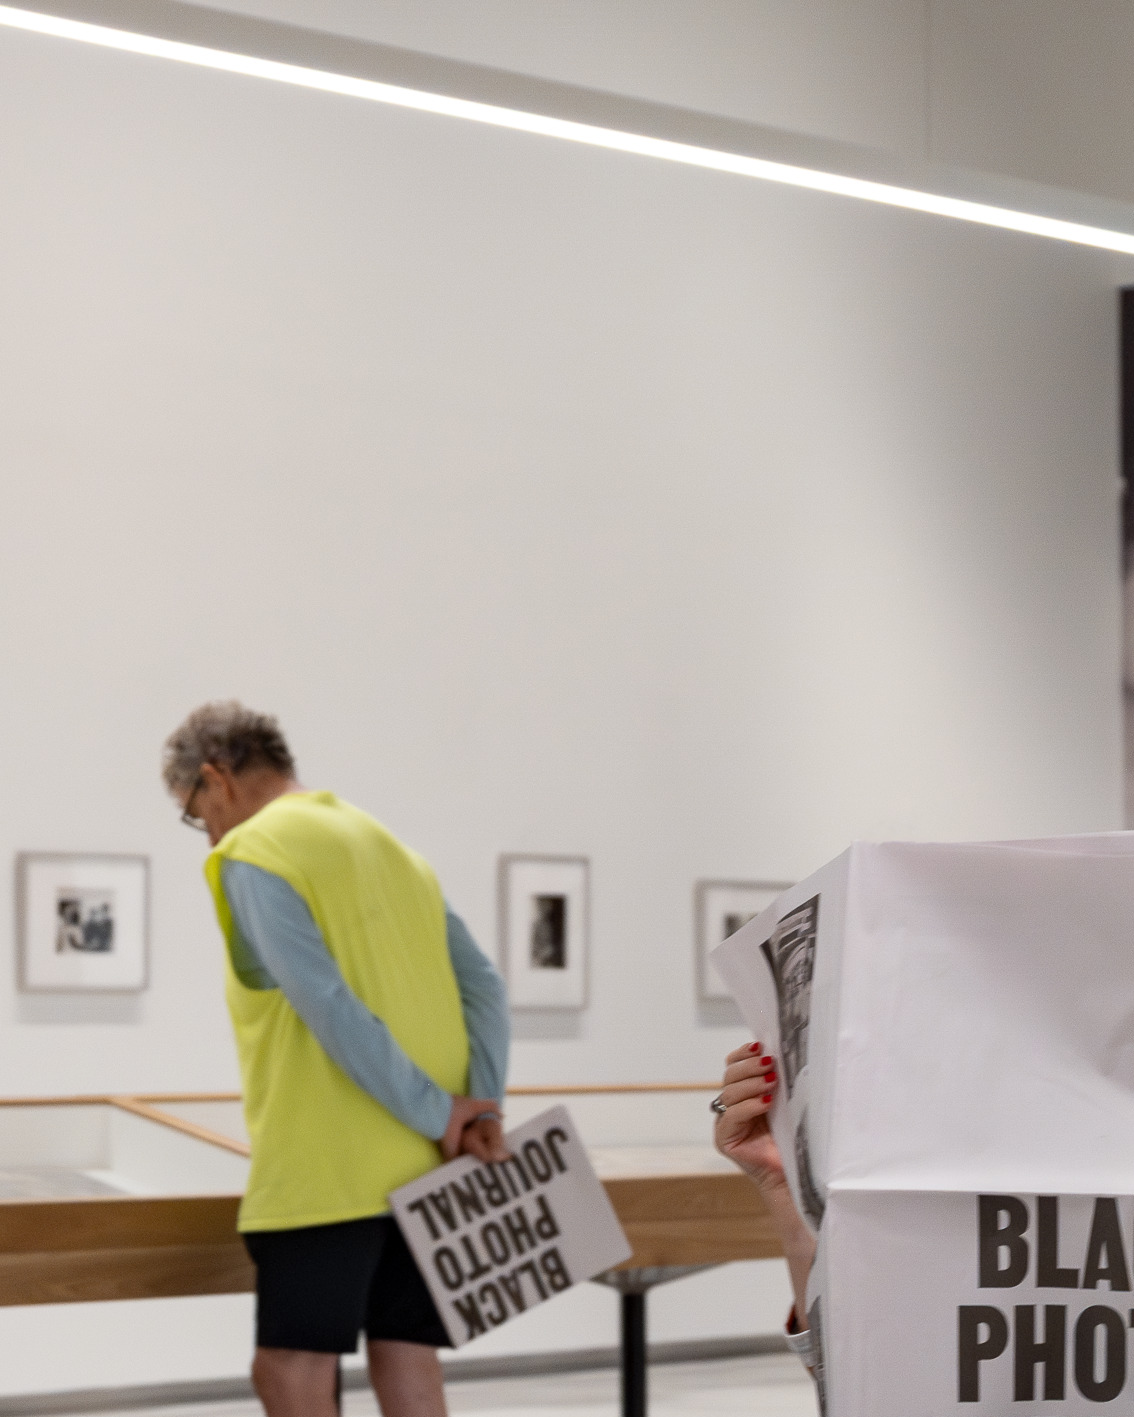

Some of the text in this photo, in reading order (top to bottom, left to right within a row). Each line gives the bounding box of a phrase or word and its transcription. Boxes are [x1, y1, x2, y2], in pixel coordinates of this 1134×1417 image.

[407, 1127, 568, 1241] JOURNAL
[433, 1194, 561, 1290] PHOTO
[452, 1246, 572, 1340] BLACK
